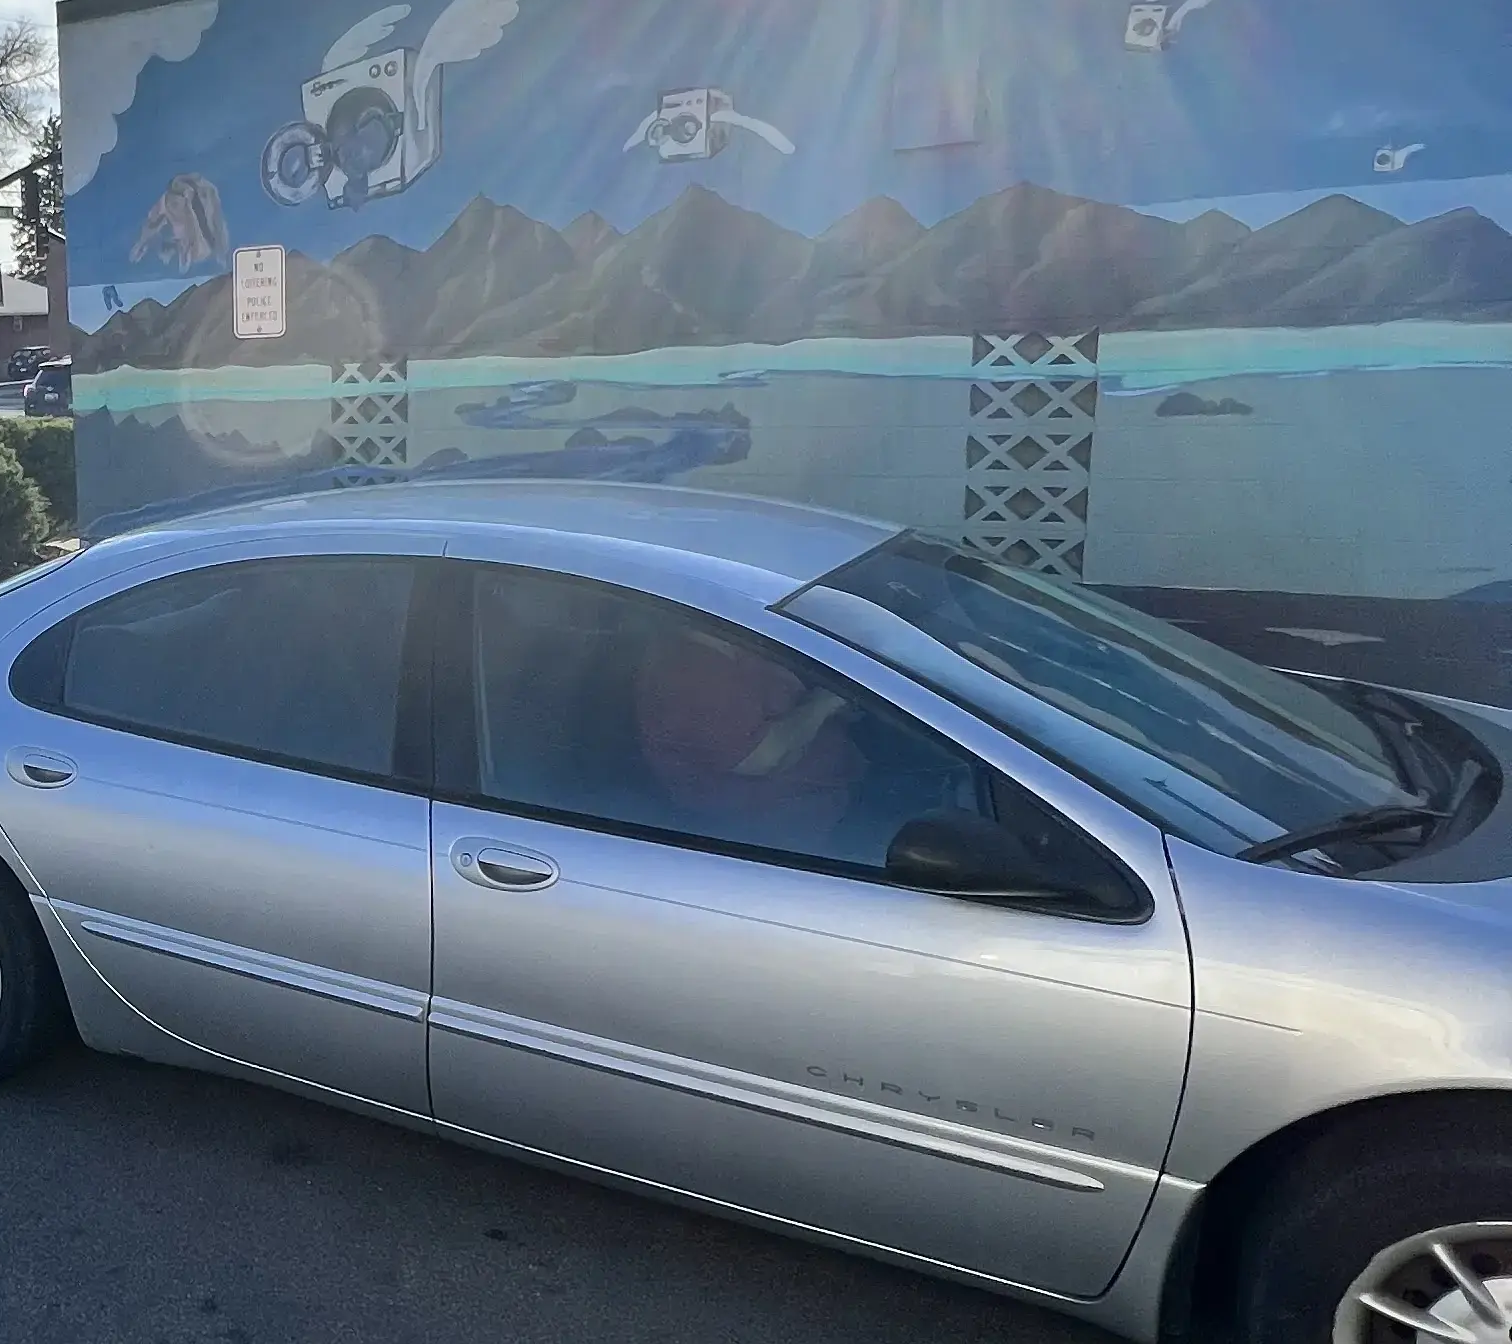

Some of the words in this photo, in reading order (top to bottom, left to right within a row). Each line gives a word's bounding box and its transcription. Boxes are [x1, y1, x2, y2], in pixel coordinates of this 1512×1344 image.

[253, 262, 264, 272] NO
[247, 296, 272, 307] POLICE
[806, 1065, 1095, 1141] CHRYSLER
